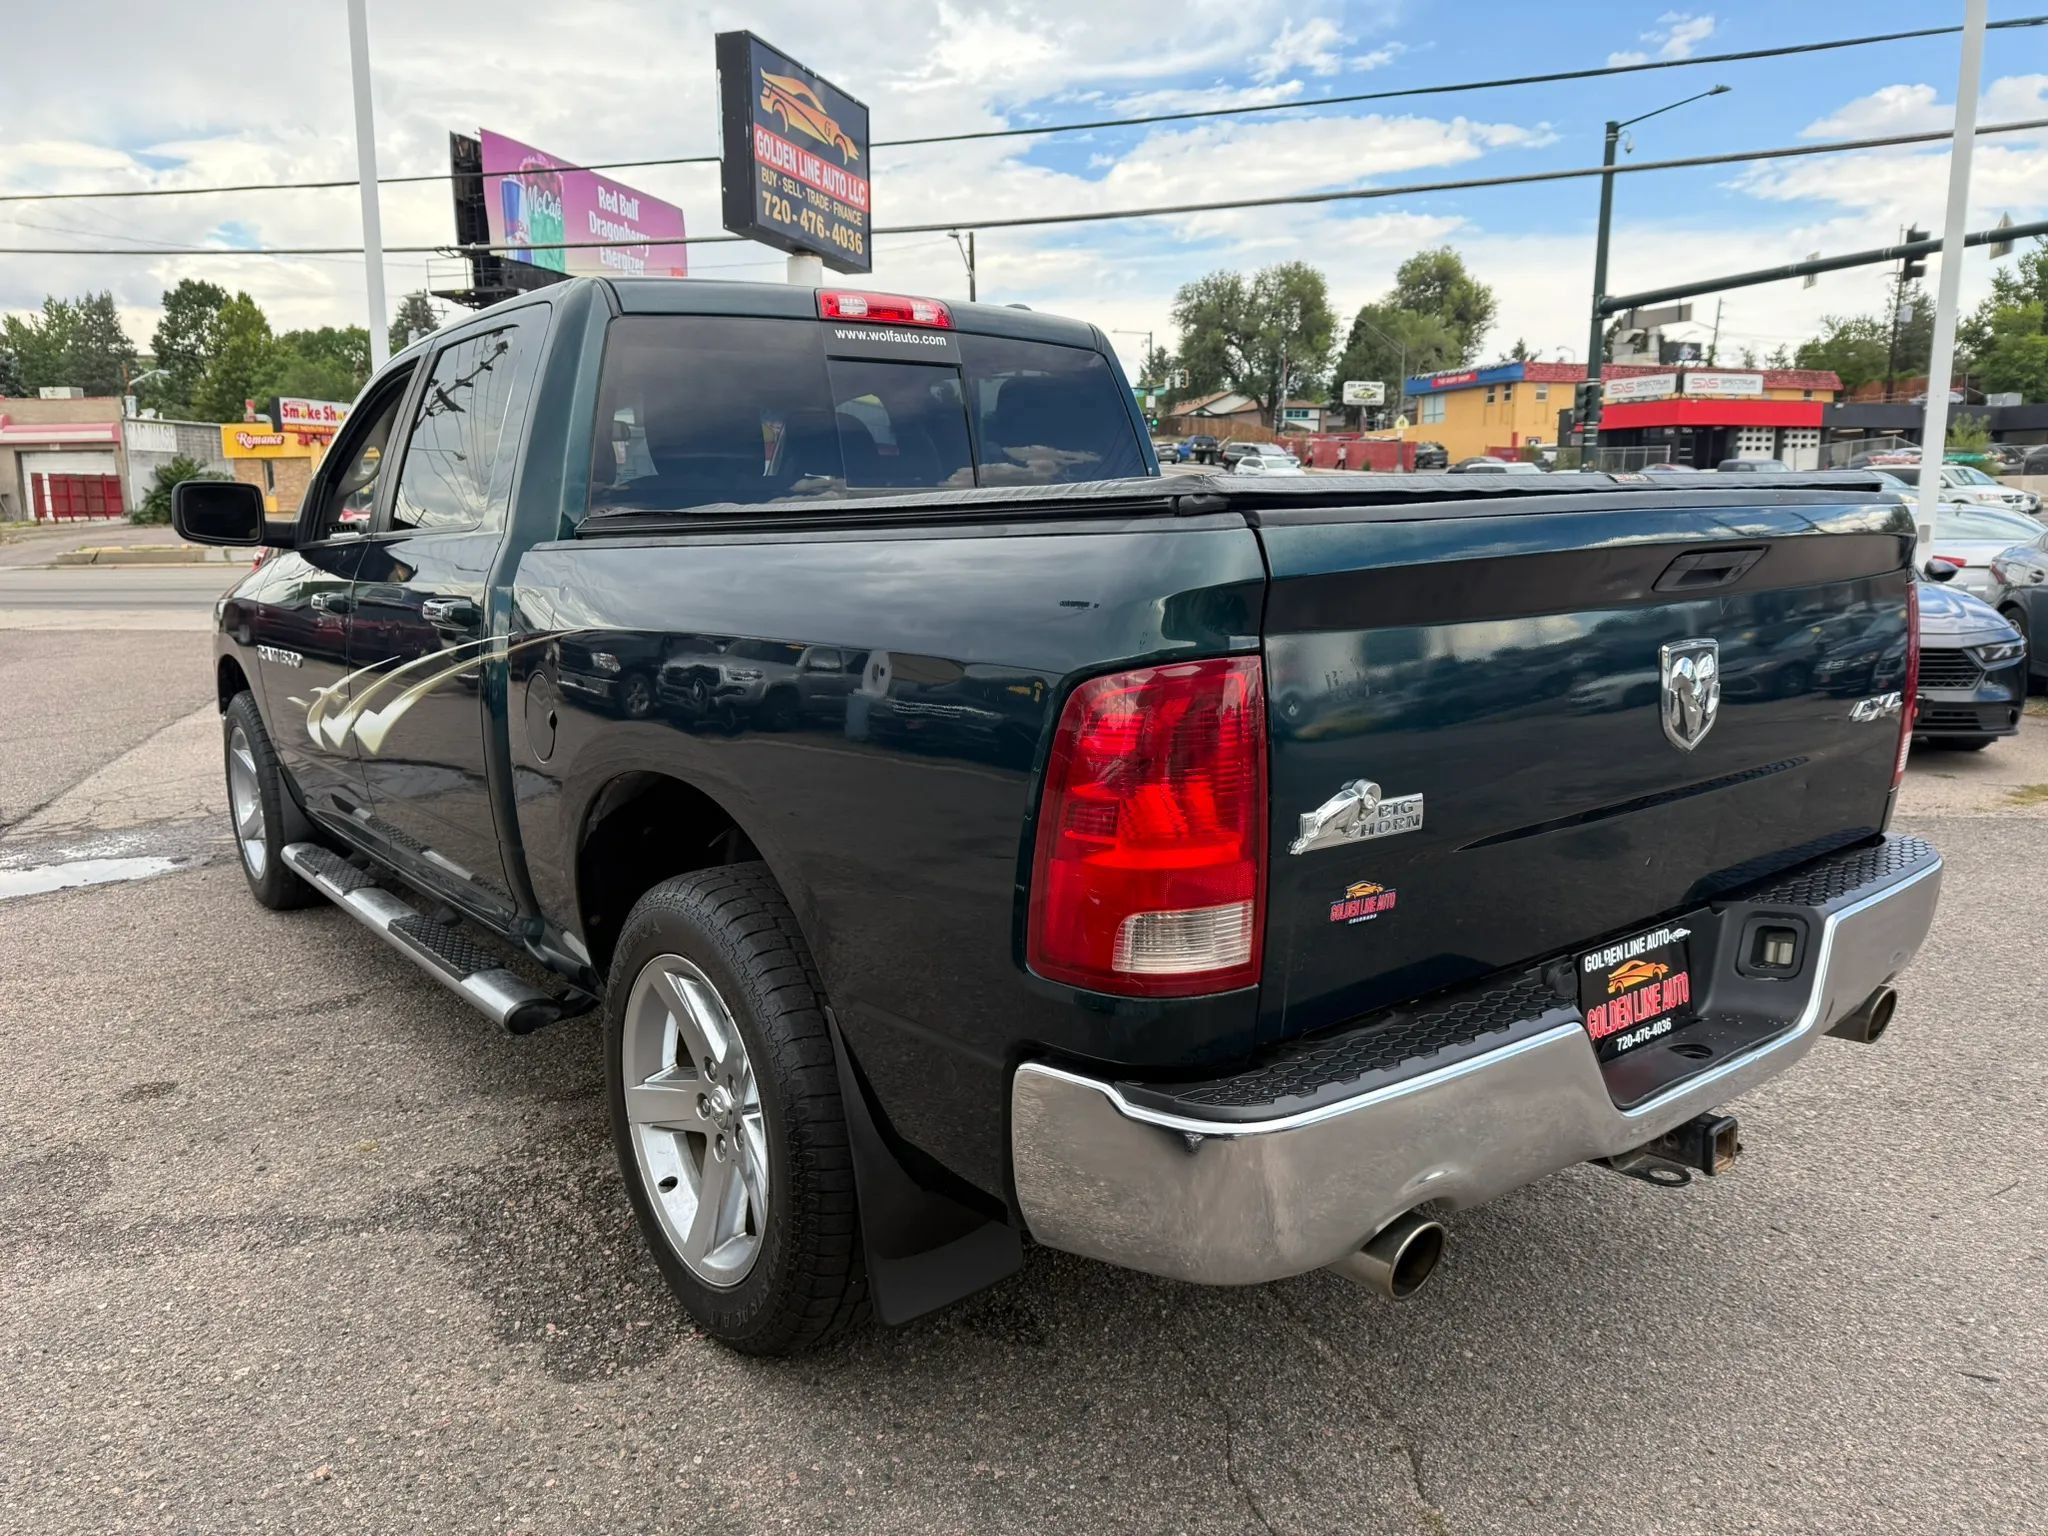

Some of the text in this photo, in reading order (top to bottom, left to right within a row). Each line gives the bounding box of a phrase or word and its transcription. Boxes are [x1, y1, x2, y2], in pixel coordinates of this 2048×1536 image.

[756, 129, 865, 206] GOLDEN LINE AUTO LLC
[597, 185, 639, 222] Red Bull
[761, 166, 863, 226] BUY SELL TRADE FINANCE
[588, 210, 651, 257] Dragonberry
[762, 190, 863, 255] 720-476-4036
[600, 246, 644, 277] Energizer
[834, 329, 947, 346] www.wolfauto.com
[1636, 379, 1671, 388] SPECTRUM
[1720, 378, 1757, 386] SPECTRUM
[282, 401, 321, 420] Smoke
[236, 432, 284, 449] Romance
[1378, 800, 1414, 818] BIG
[1360, 814, 1421, 838] HORN
[1330, 891, 1396, 922] GOLDEN LINE AUTO
[1584, 928, 1670, 973] GOLDEN LINE AUTO
[1587, 971, 1690, 1041] GOLDEN LINE AUTO
[1616, 1017, 1672, 1051] 720-476-4036
